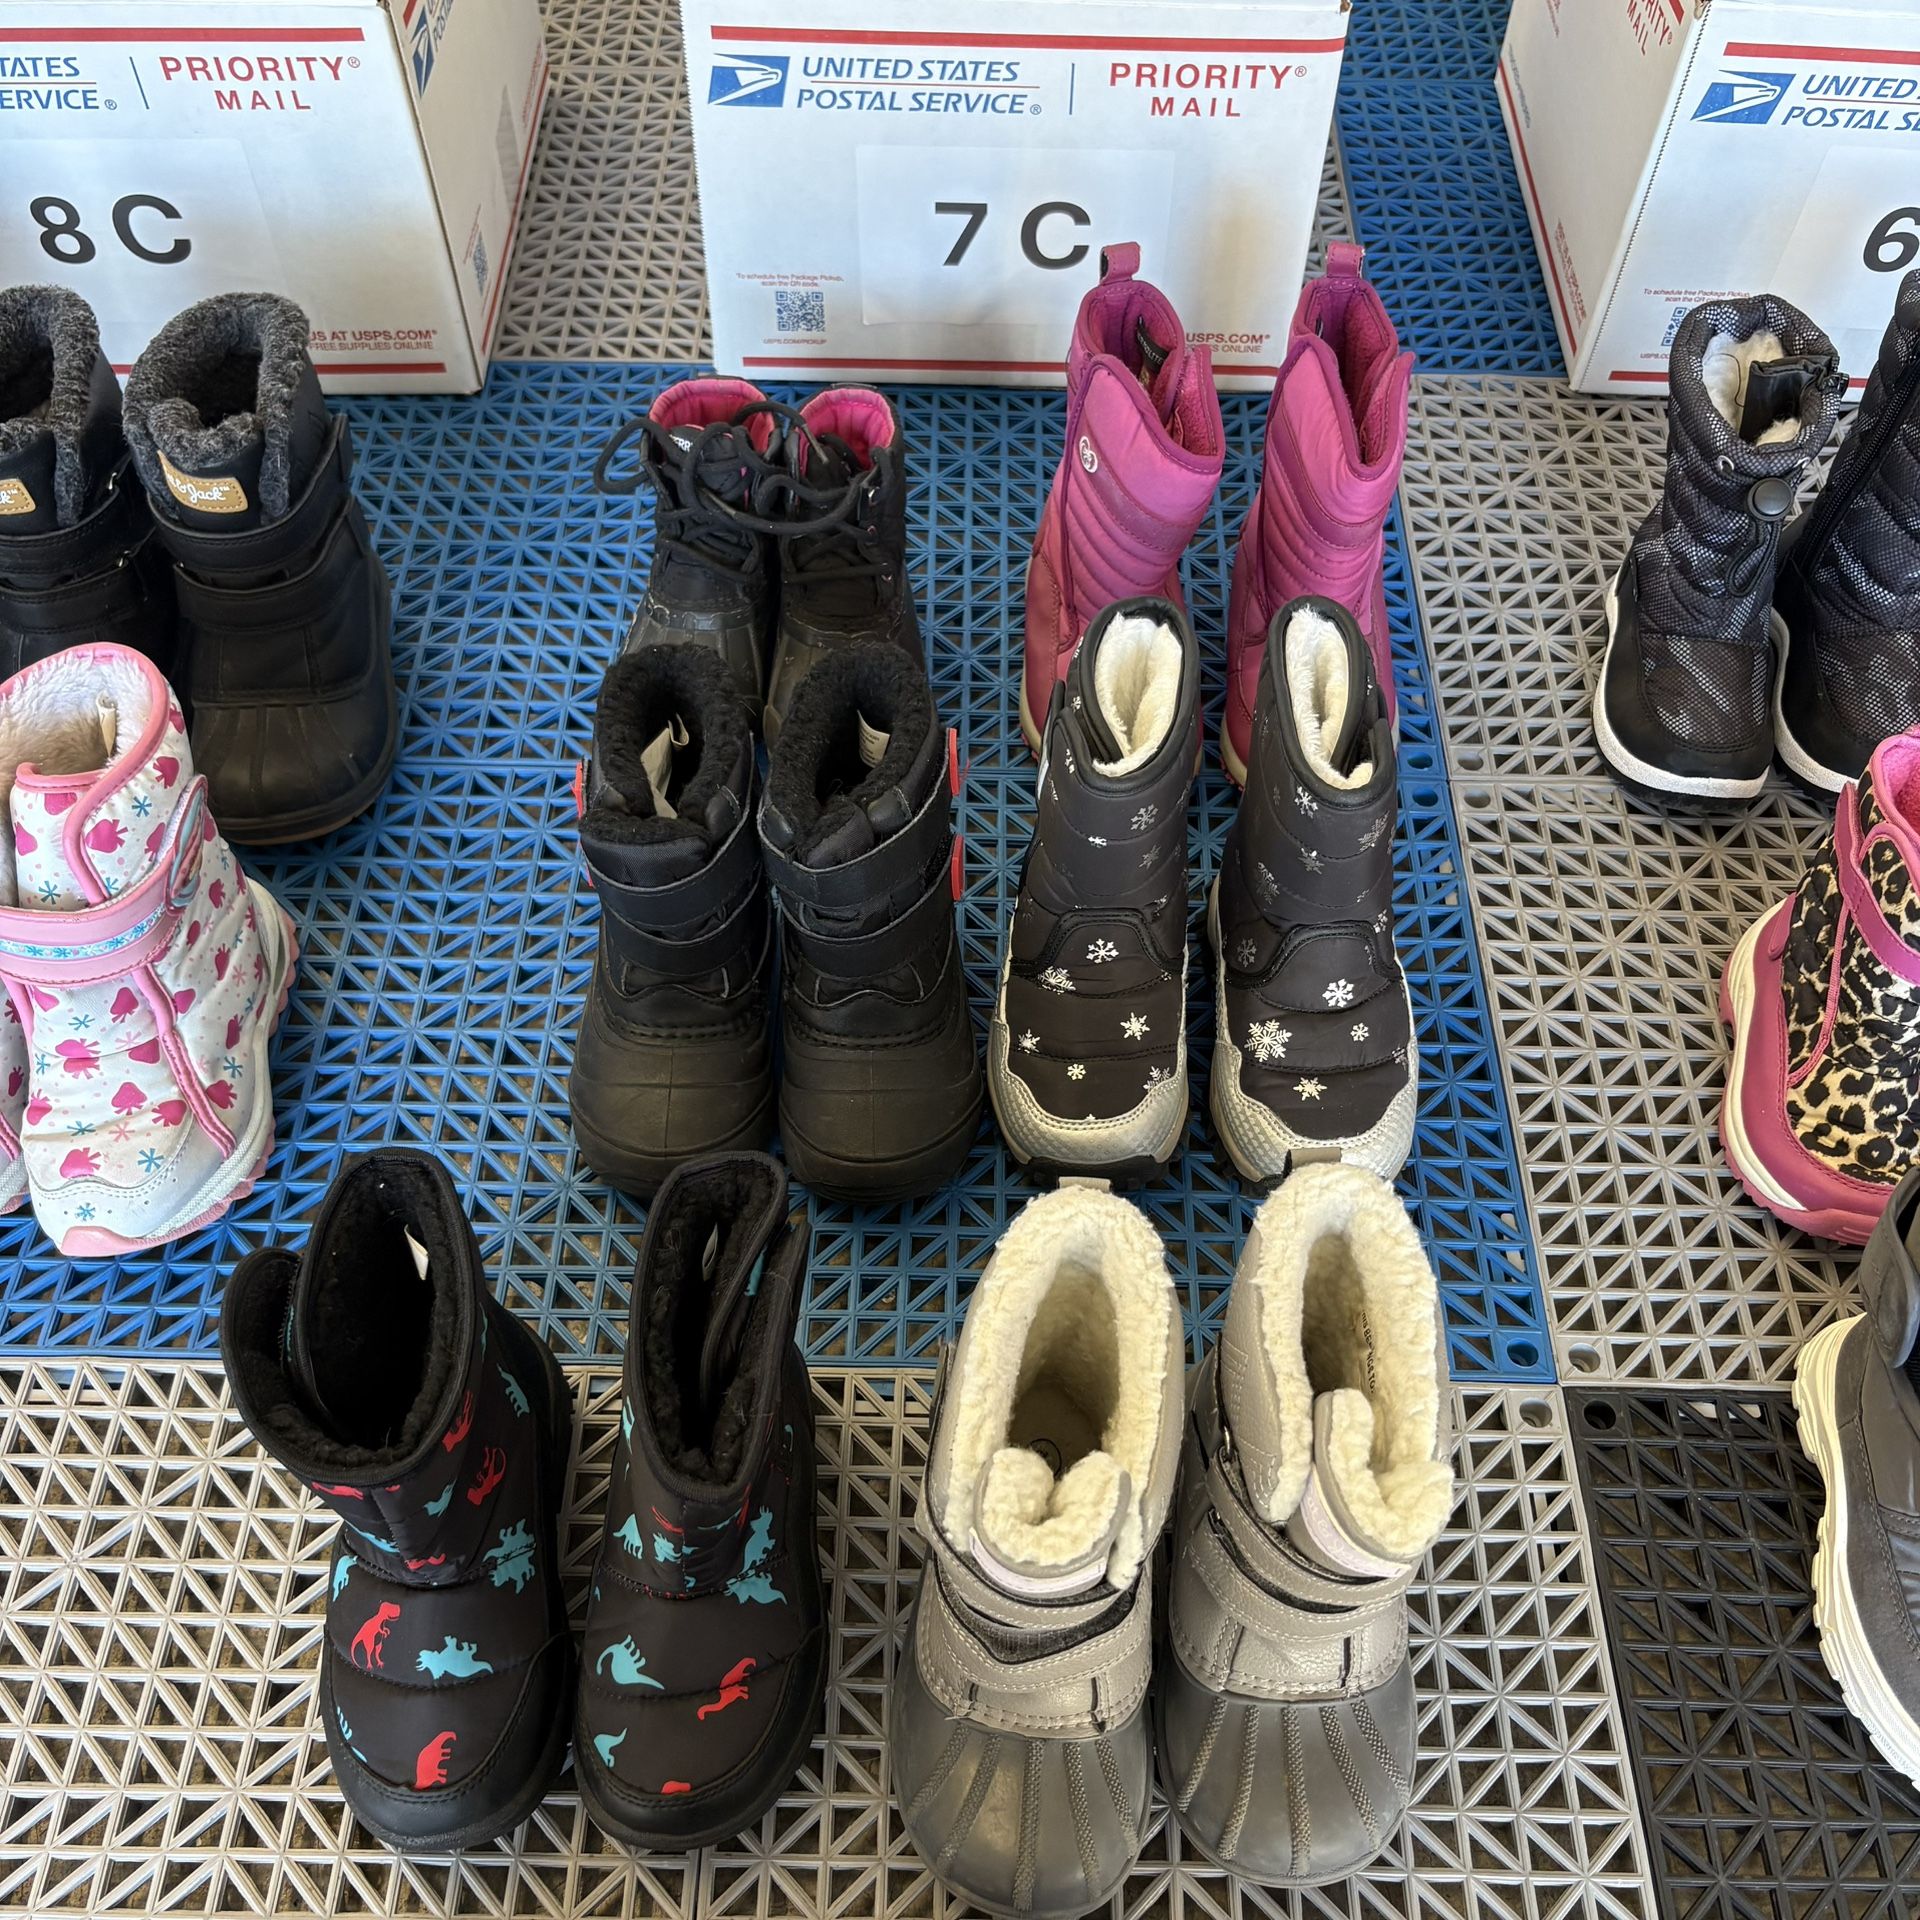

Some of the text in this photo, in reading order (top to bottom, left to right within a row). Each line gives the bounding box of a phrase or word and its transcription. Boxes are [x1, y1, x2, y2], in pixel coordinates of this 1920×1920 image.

[802, 56, 1020, 82] UNITED STATES
[1802, 74, 1918, 98] UNITED
[214, 90, 311, 110] MAIL
[797, 89, 902, 111] POSTAL
[1150, 97, 1241, 117] MAIL
[1781, 106, 1890, 129] POSTAL
[29, 193, 192, 265] 8 C
[934, 201, 1092, 270] 7 C
[1862, 206, 1920, 273] 6
[331, 330, 347, 341] AT
[1222, 344, 1262, 354] ONLINE
